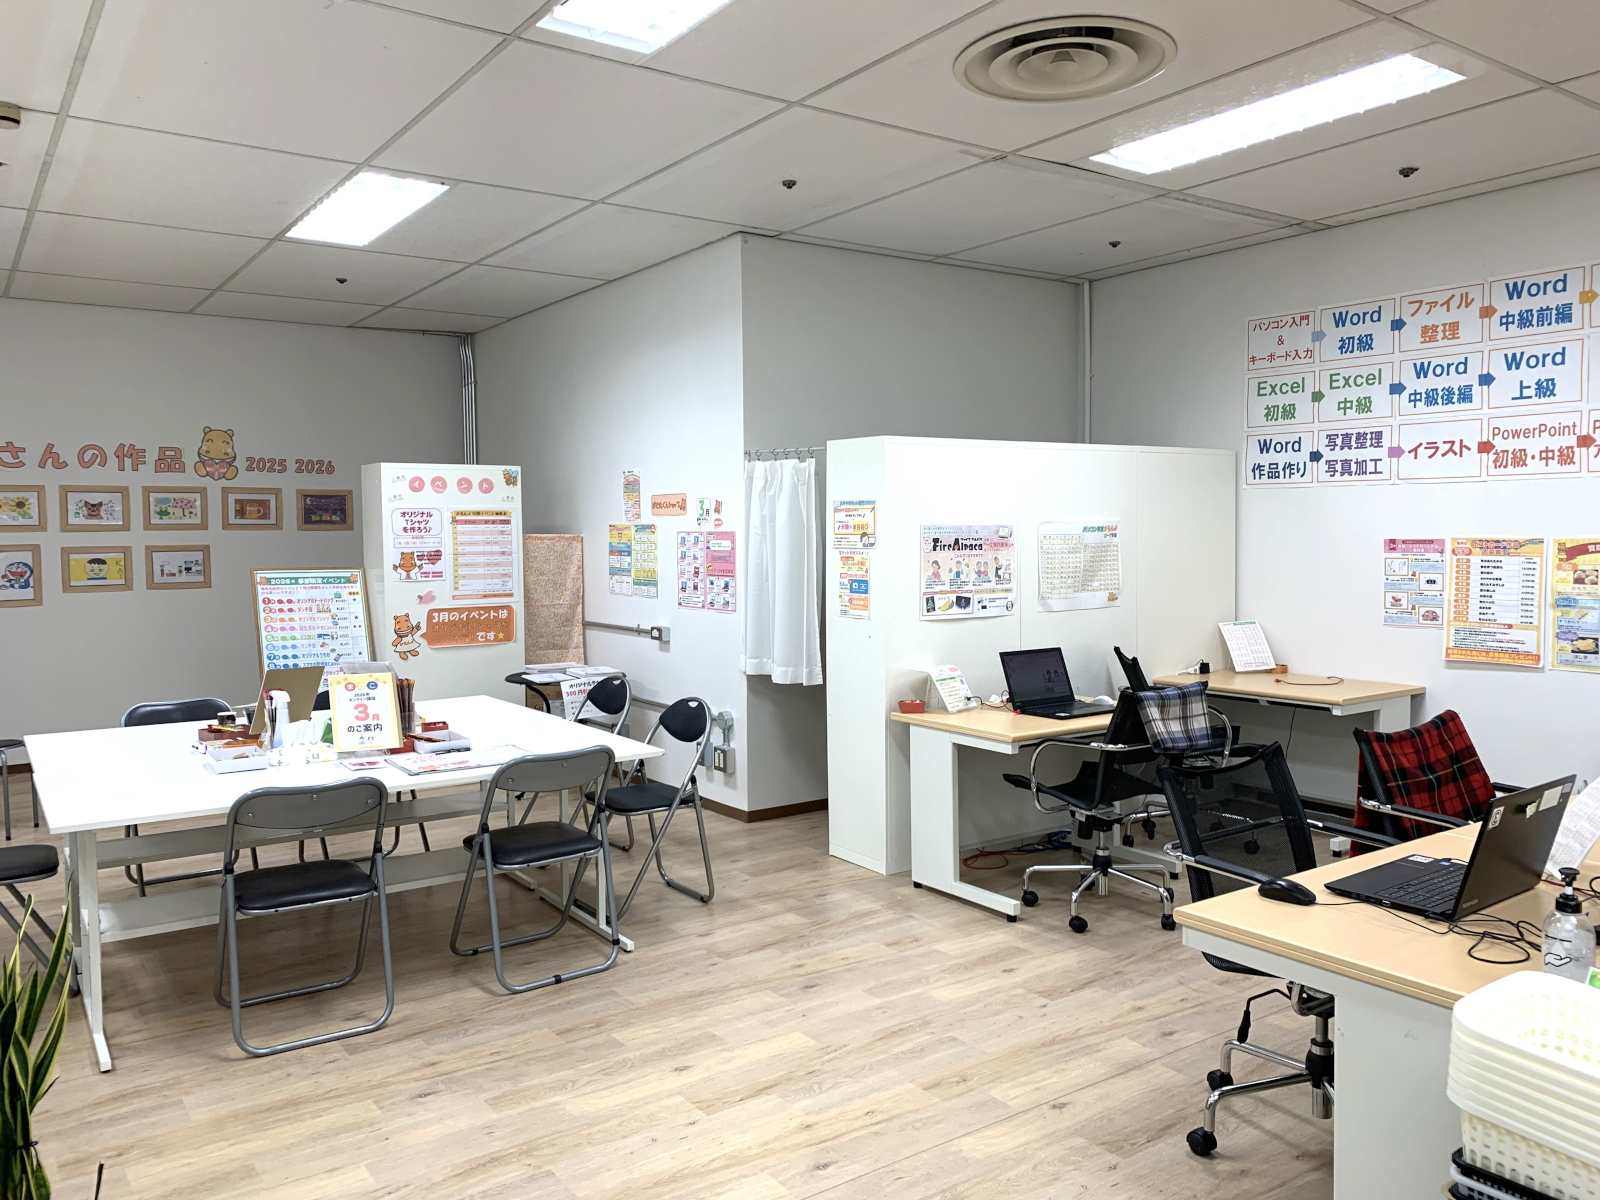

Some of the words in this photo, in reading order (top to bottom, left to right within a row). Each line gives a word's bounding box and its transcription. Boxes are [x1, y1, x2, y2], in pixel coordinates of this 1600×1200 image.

[1505, 273, 1568, 300] Word
[1408, 292, 1475, 317] ファイル
[1253, 315, 1310, 331] パソコン入門
[1332, 306, 1382, 328] Word
[1500, 302, 1574, 332] 中級前編
[1277, 335, 1284, 345] &
[1420, 320, 1460, 344] 整理
[1338, 334, 1374, 354] 初級
[1250, 348, 1312, 365] キーボード入力
[1504, 346, 1566, 371] Word
[1413, 357, 1468, 380] Word
[1257, 377, 1304, 397] Excel
[1330, 368, 1382, 390] Excel
[1512, 378, 1557, 400] 上級
[1337, 396, 1373, 416] 中級
[1408, 384, 1473, 408] 中級後編
[1264, 403, 1296, 422] 初級
[1325, 430, 1383, 451] 写真整理
[1492, 422, 1577, 441] PowerPoint
[1258, 436, 1301, 454] Word
[1408, 439, 1471, 459] イラスト
[0, 441, 186, 474] さんの作品
[246, 456, 287, 473] 2025
[295, 458, 335, 474] 2026
[1325, 458, 1383, 477] 写真加工
[1492, 446, 1576, 469] 初級・中級
[1252, 461, 1306, 480] 作品作り
[933, 538, 983, 551] FireAlpaca
[432, 610, 508, 622] 3月のイベントは
[476, 631, 495, 641] です
[354, 703, 380, 721] 3月
[348, 723, 382, 732] のご案内
